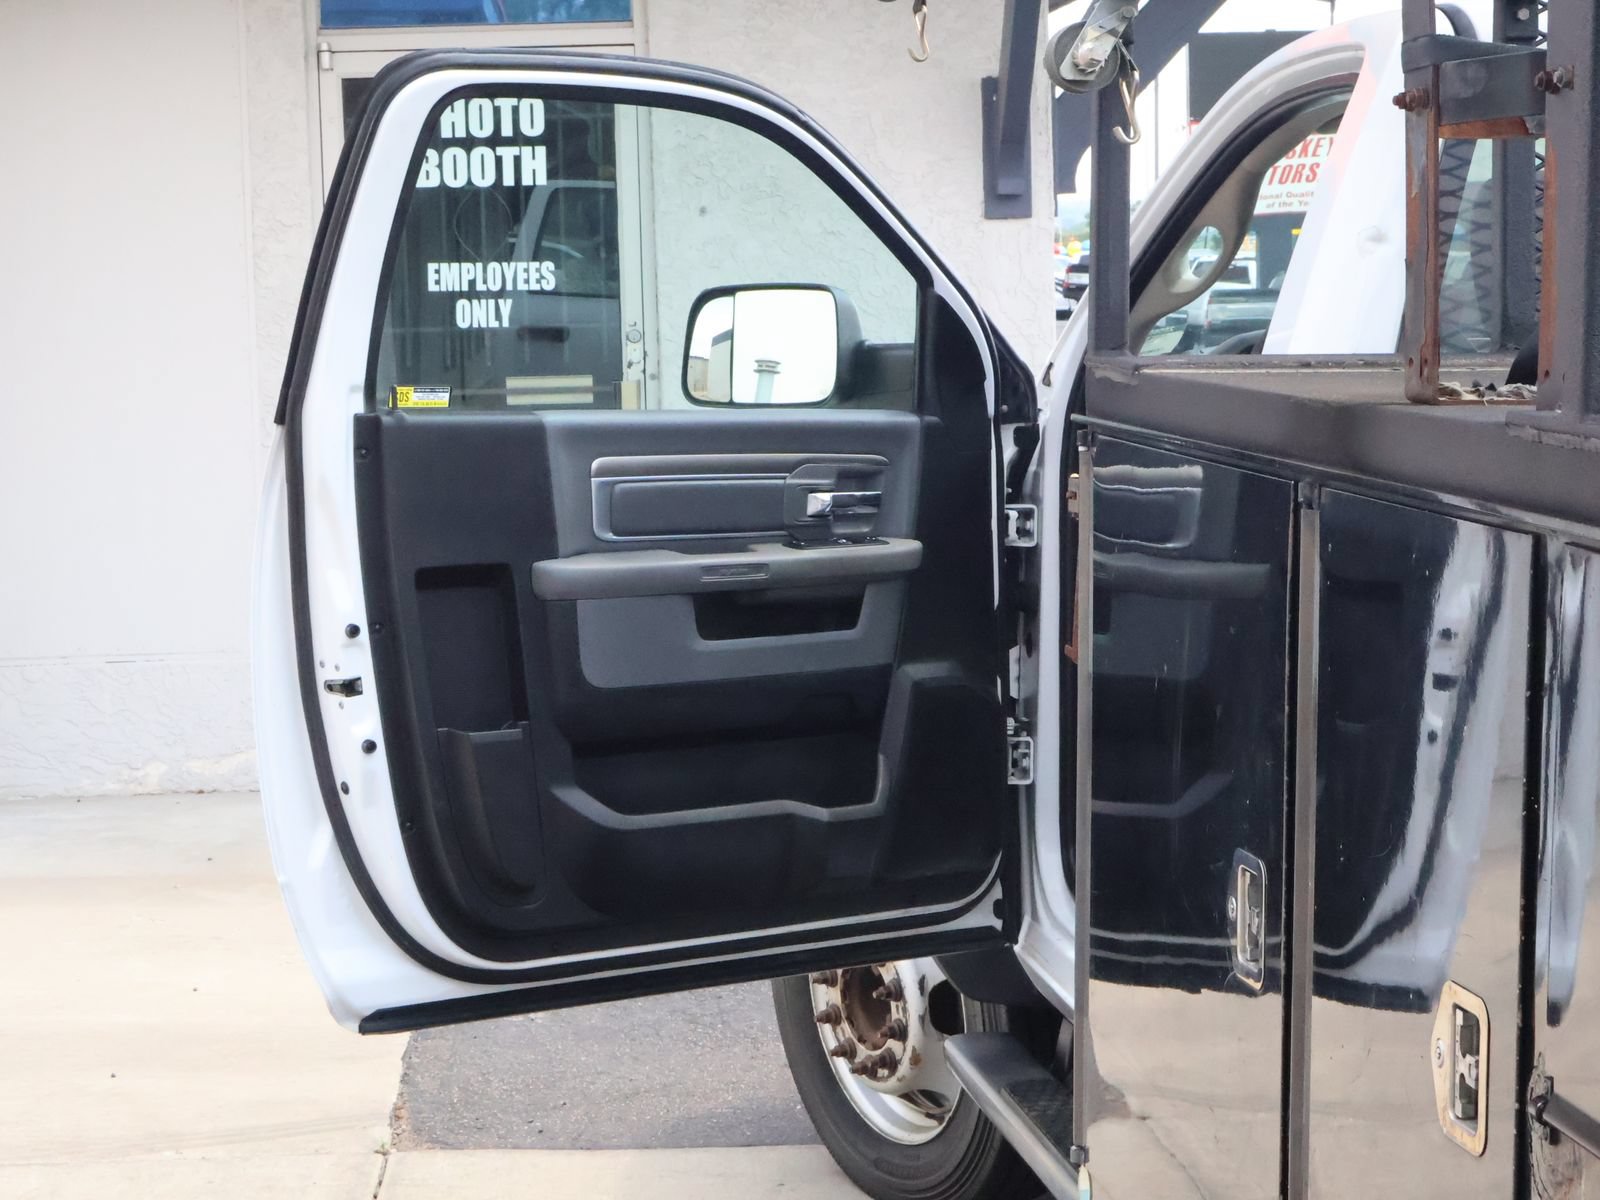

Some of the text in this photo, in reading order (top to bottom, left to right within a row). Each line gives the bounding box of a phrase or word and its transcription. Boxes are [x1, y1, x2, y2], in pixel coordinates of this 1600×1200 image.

[440, 97, 545, 139] HOTO
[415, 145, 548, 188] BOOTH
[1268, 162, 1321, 186] TORS
[1265, 201, 1276, 209] of
[1278, 200, 1294, 208] the
[427, 260, 557, 292] EMPLOYEES
[455, 298, 513, 329] ONLY
